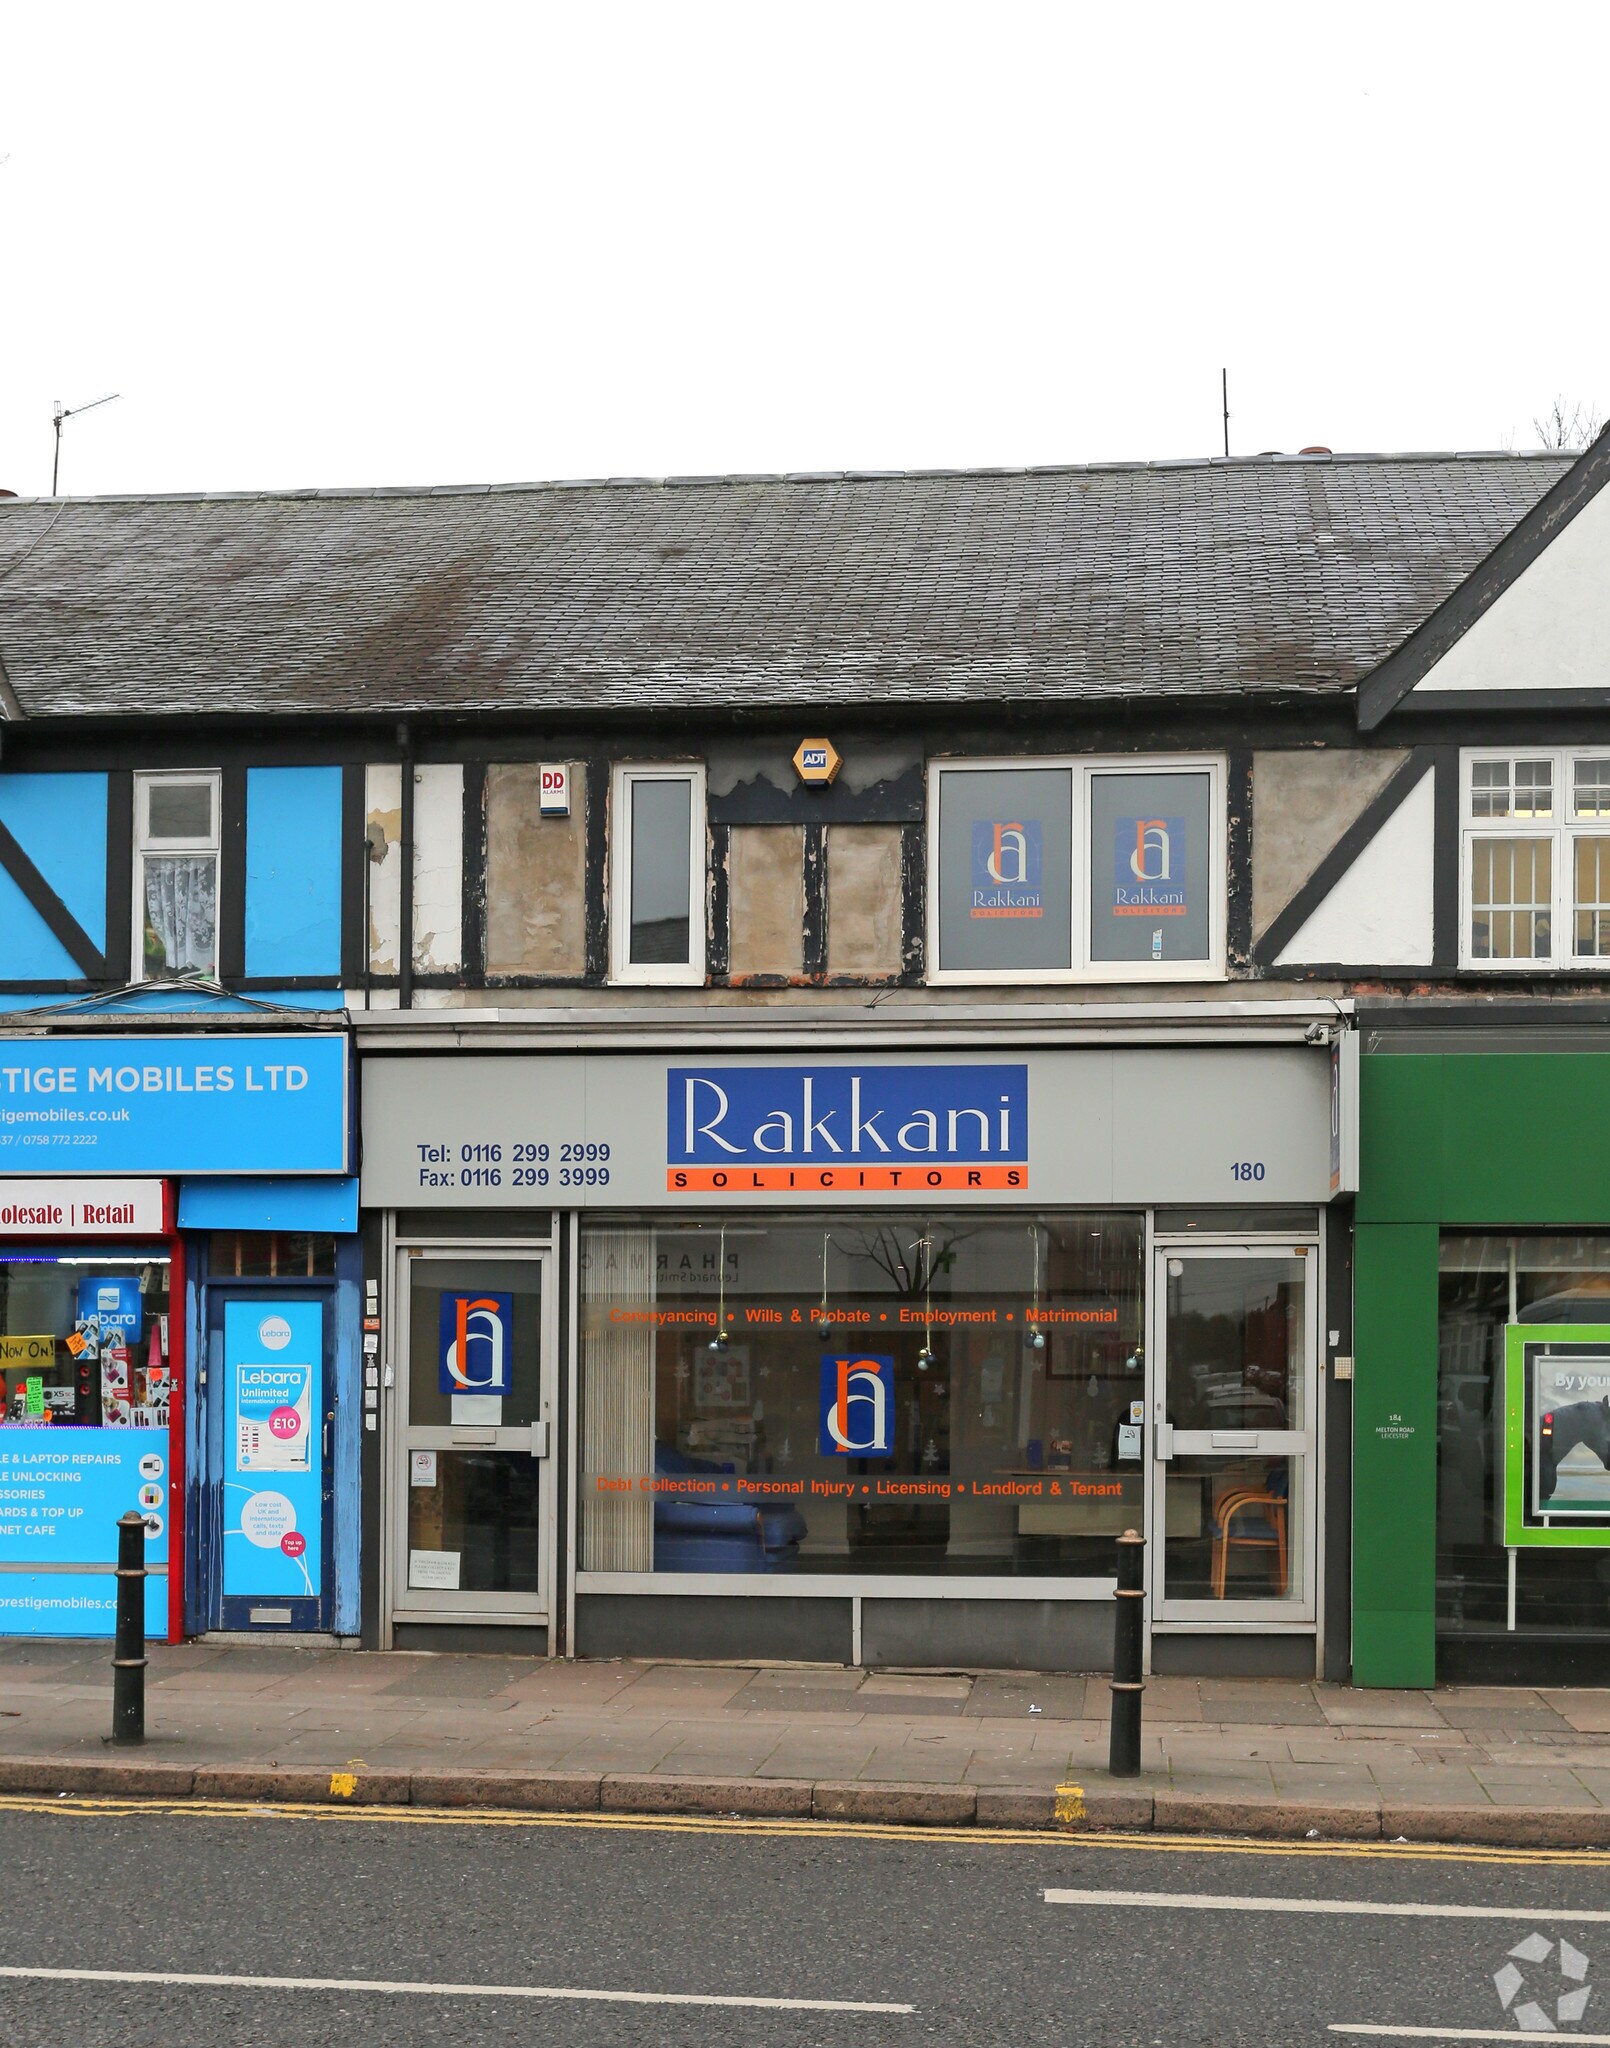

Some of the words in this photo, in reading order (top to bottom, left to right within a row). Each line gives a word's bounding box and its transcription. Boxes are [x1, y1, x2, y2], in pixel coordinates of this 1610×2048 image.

[804, 750, 826, 767] ADT
[542, 772, 564, 789] DD
[973, 890, 1040, 907] Rakkani
[1116, 887, 1184, 904] Rakkani
[0, 1067, 77, 1093] TIGE
[88, 1066, 234, 1092] MOBILES
[245, 1065, 309, 1091] LTD
[685, 1076, 1010, 1154] Rakkani
[23, 1135, 49, 1145] 0758
[52, 1135, 70, 1145] 772
[73, 1135, 98, 1145] 2222
[417, 1144, 451, 1162] Tel:
[461, 1145, 502, 1162] 0116
[512, 1145, 550, 1162] 299
[560, 1145, 611, 1162] 2999
[419, 1169, 454, 1187] Fax:
[461, 1169, 502, 1187] 0116
[512, 1168, 550, 1186] 299
[560, 1168, 611, 1186] 3999
[675, 1171, 1020, 1187] SOLICITORS
[1230, 1163, 1266, 1181] 180
[0, 1204, 63, 1224] olesale
[83, 1204, 135, 1224] Retail
[610, 1308, 718, 1326] Conveyancing
[745, 1308, 783, 1323] Wills
[790, 1308, 803, 1323] &
[810, 1308, 871, 1323] Probate
[899, 1308, 997, 1326] Employment
[1025, 1307, 1118, 1323] Matrimonial
[261, 1328, 290, 1338] Lebara
[241, 1369, 301, 1384] Lebara
[1555, 1372, 1575, 1390] By
[241, 1388, 289, 1397] Unlimited
[273, 1417, 297, 1430] £10
[1389, 1413, 1402, 1422] 184
[12, 1454, 20, 1464] &
[23, 1454, 69, 1464] LAPTOP
[72, 1454, 122, 1465] REPAIRS
[12, 1471, 82, 1482] UNLOCKING
[596, 1476, 633, 1492] Debt
[639, 1477, 716, 1493] Collection
[737, 1479, 804, 1494] Personal
[811, 1480, 855, 1497] Injury
[877, 1480, 951, 1498] Licensing
[972, 1481, 1043, 1495] Landlord
[1049, 1481, 1062, 1496] &
[1070, 1481, 1122, 1496] Tenant
[30, 1507, 38, 1518] &
[41, 1507, 65, 1518] TOP
[67, 1508, 84, 1518] UP
[24, 1525, 56, 1535] CAFE
